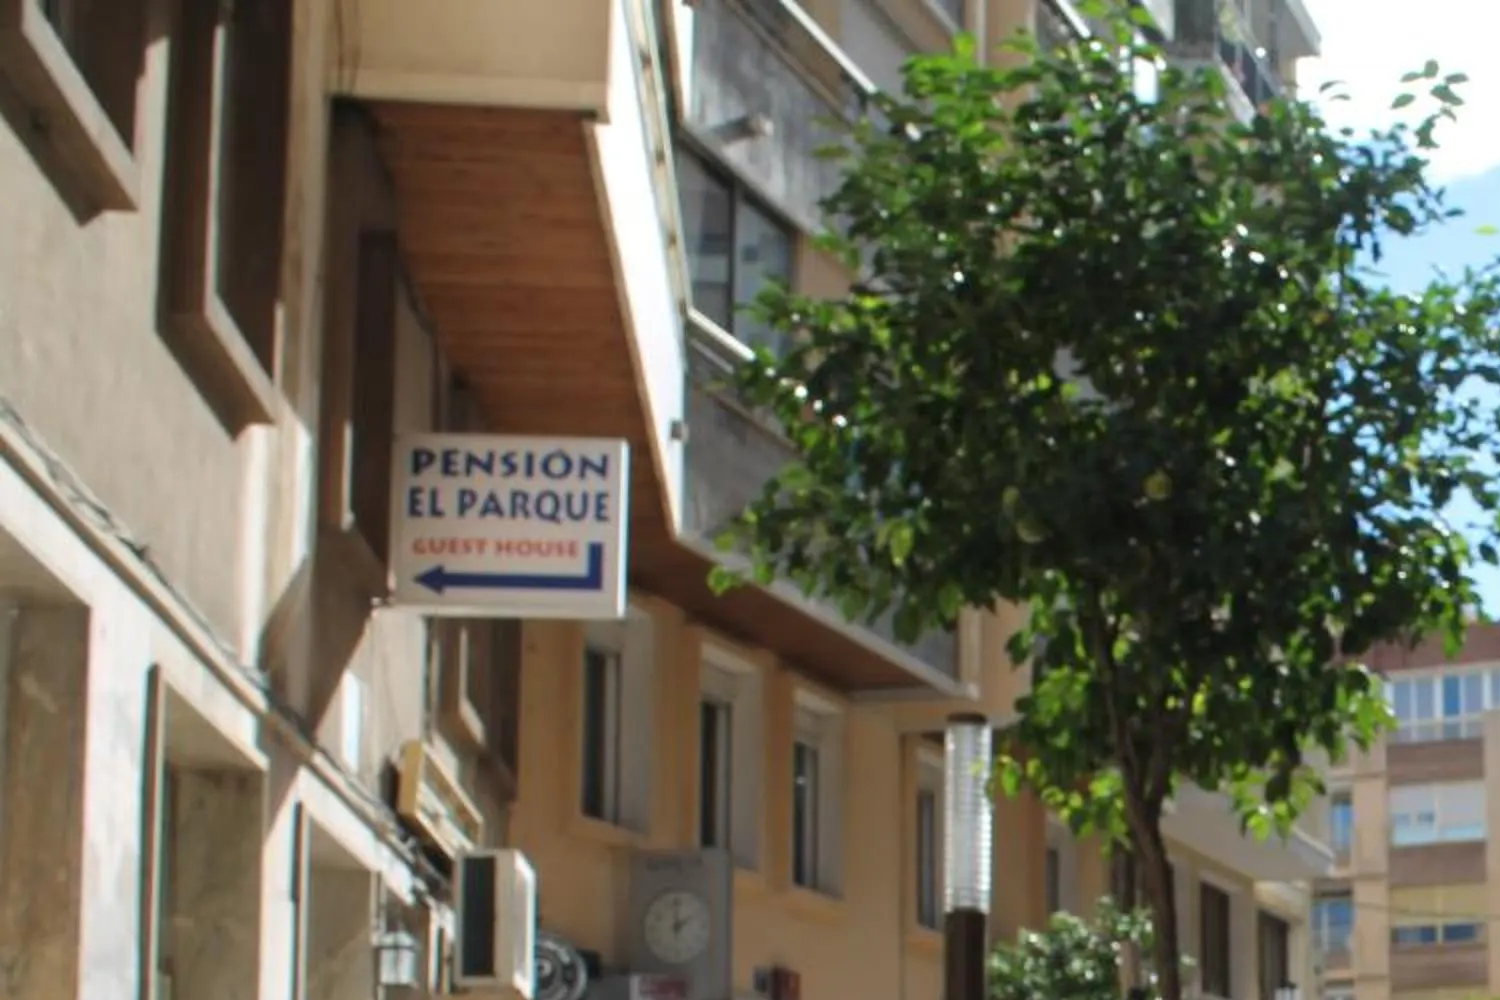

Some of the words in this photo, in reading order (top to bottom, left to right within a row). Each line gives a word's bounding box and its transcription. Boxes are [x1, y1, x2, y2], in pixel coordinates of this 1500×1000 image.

[408, 485, 446, 518] EL
[457, 488, 610, 524] PARQUE
[412, 537, 486, 556] GUEST
[496, 539, 578, 558] HOUSE
